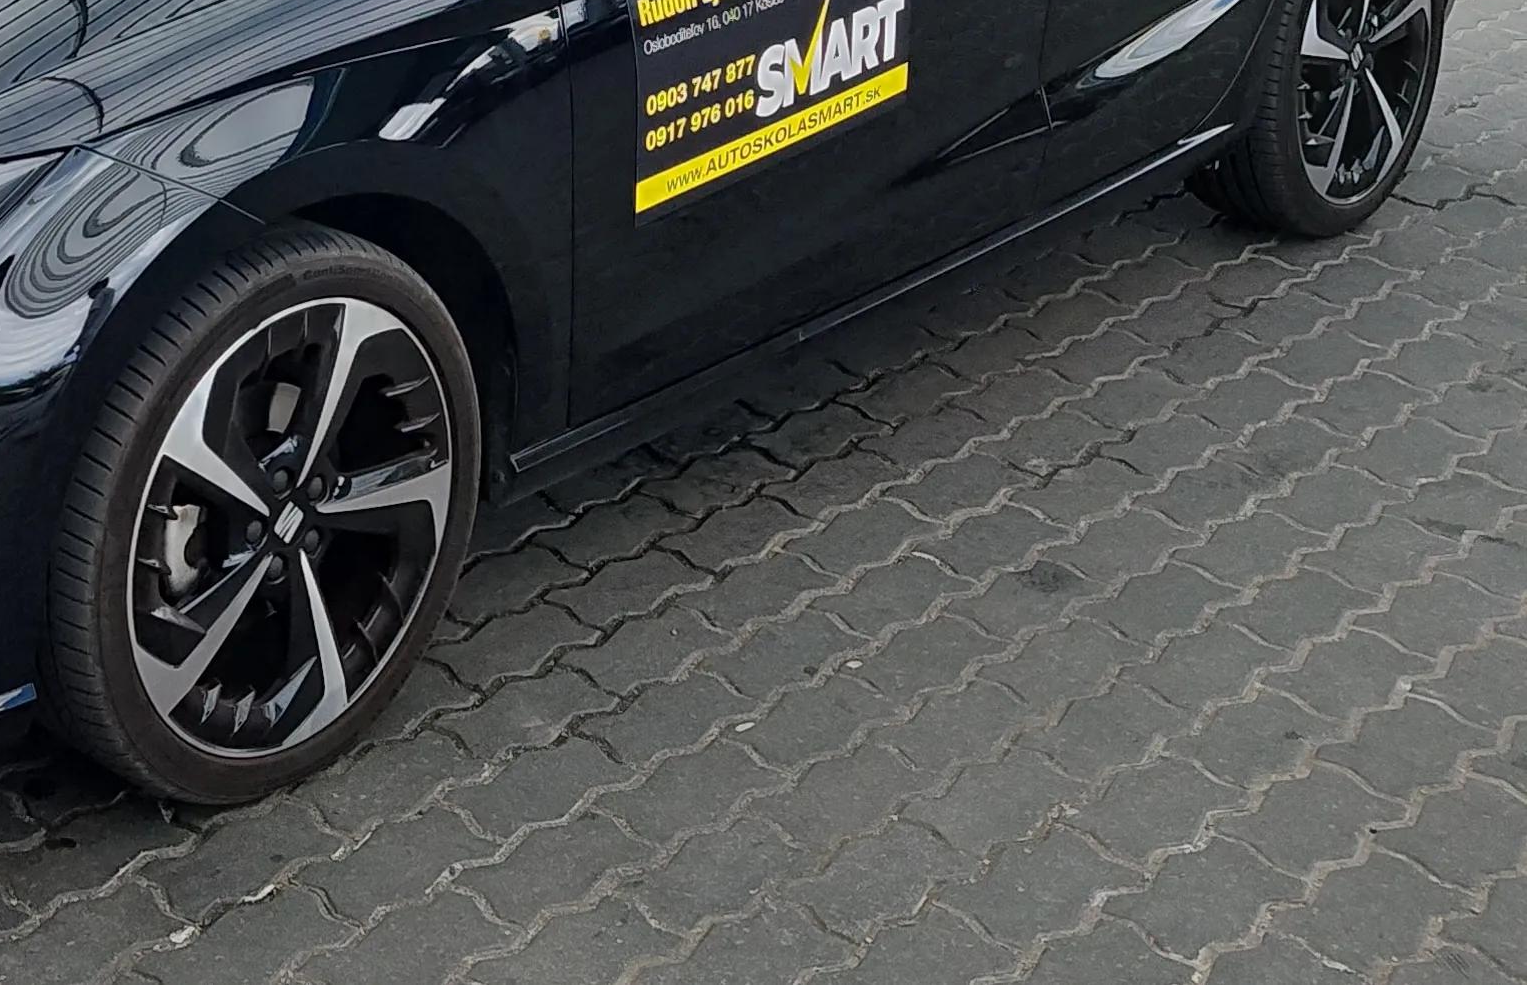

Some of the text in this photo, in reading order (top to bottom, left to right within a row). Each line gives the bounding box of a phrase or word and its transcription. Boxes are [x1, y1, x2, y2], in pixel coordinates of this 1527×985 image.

[742, 2, 754, 20] 17
[645, 53, 757, 116] 0903 747 877
[644, 88, 755, 152] 0917 976 016
